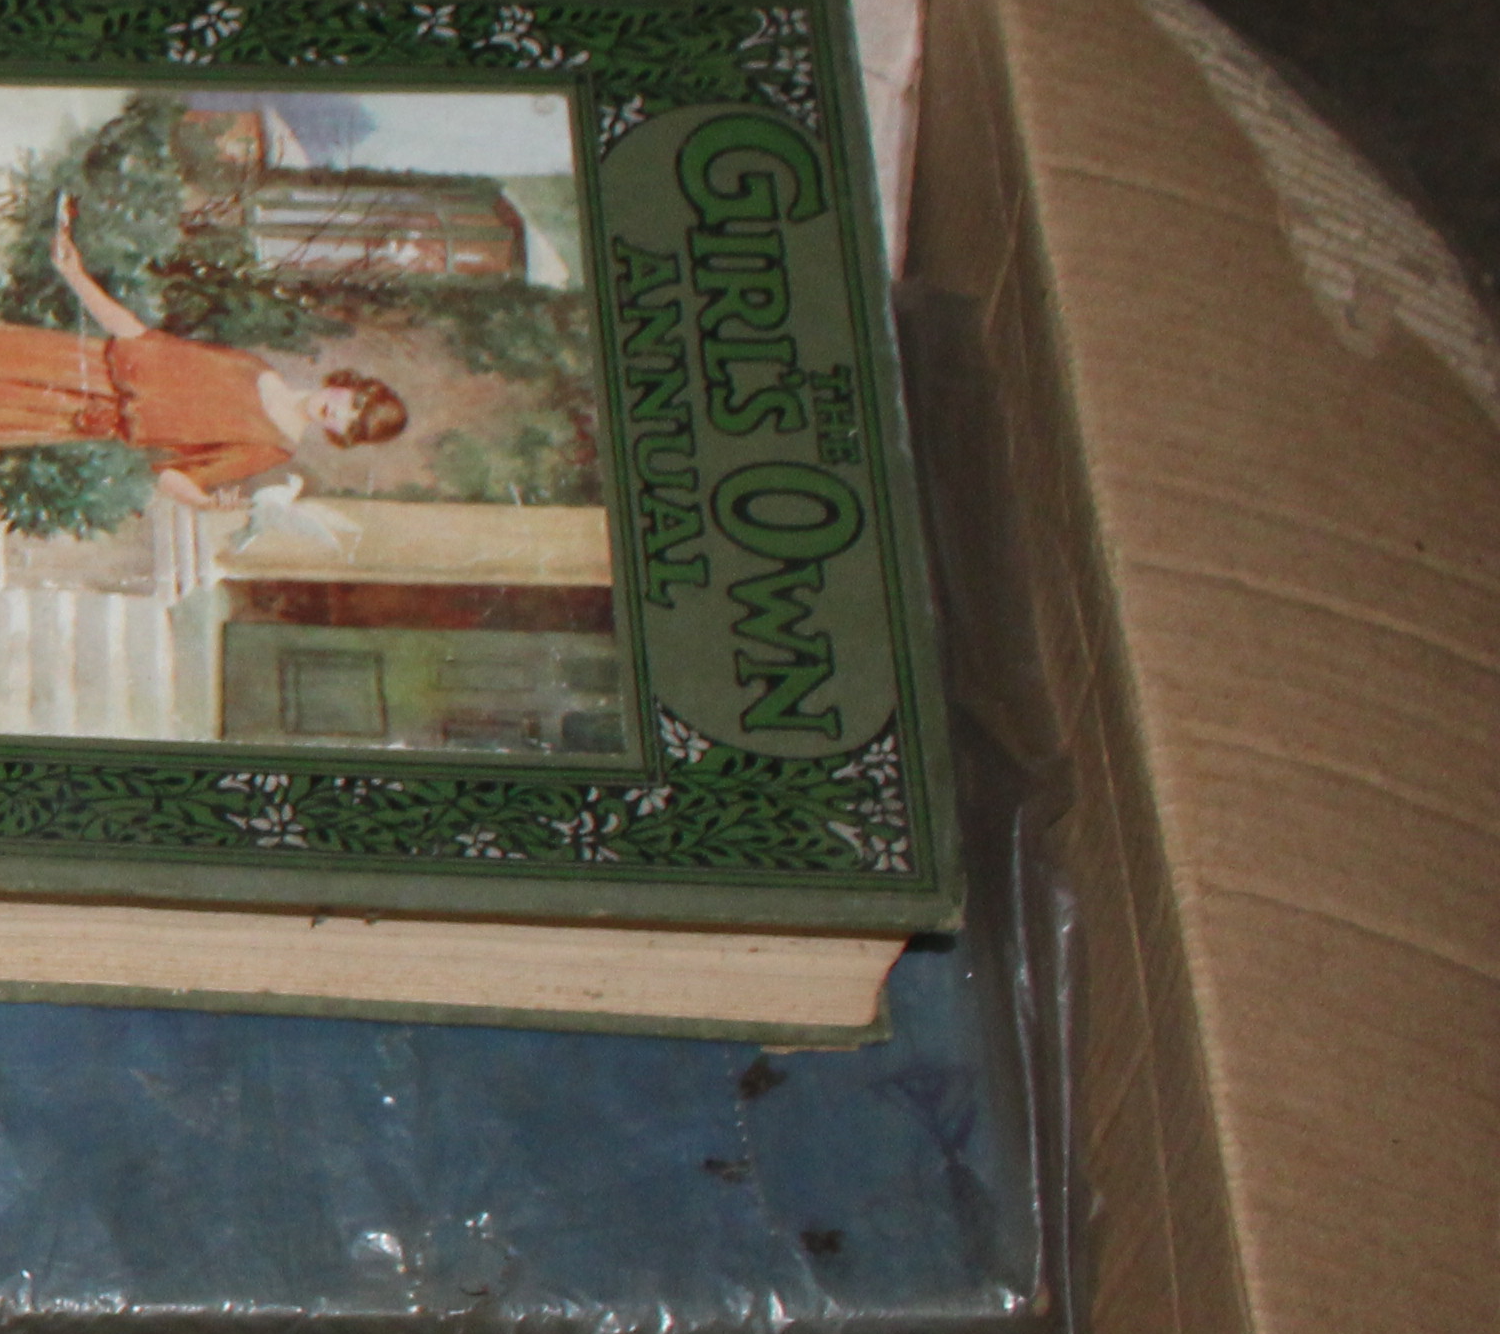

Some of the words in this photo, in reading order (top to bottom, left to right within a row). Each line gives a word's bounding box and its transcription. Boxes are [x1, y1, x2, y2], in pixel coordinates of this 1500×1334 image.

[610, 233, 711, 610] ANNUAL
[675, 110, 829, 438] GIRL'S
[809, 364, 863, 468] THE
[707, 458, 867, 742] OWN
